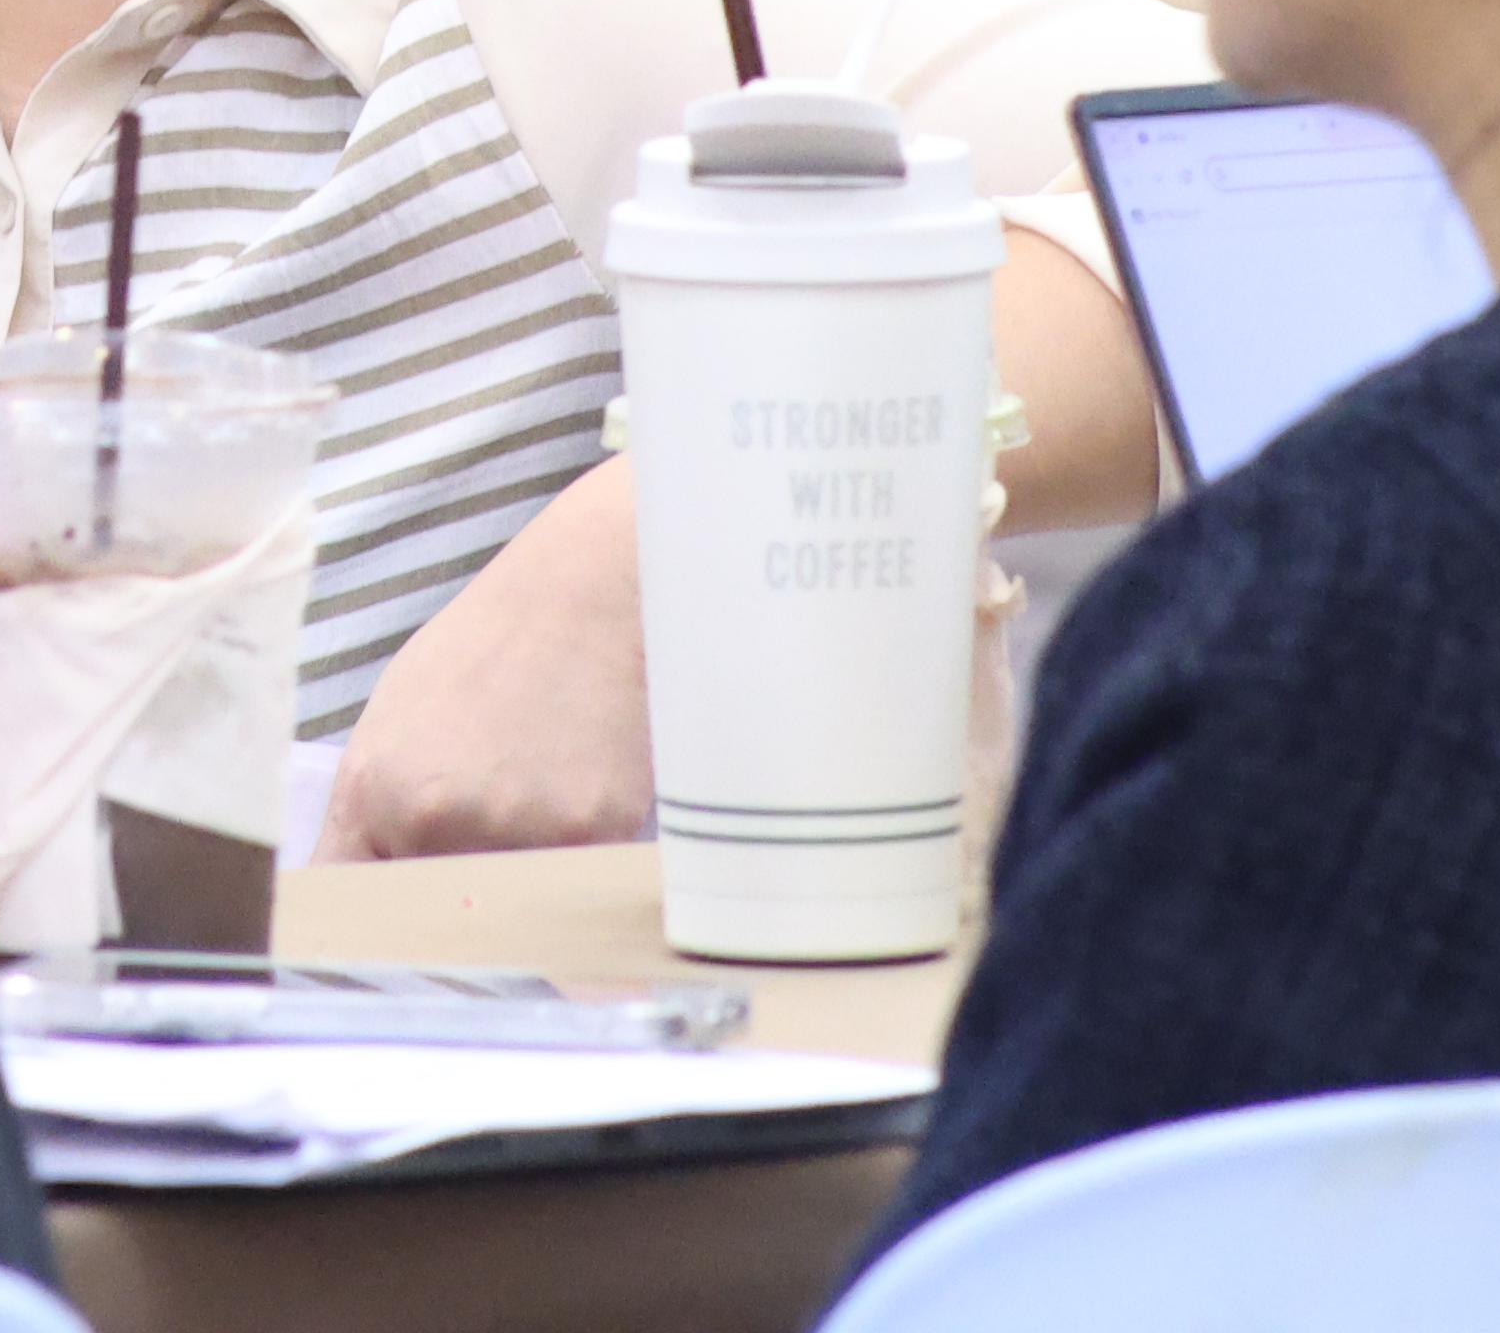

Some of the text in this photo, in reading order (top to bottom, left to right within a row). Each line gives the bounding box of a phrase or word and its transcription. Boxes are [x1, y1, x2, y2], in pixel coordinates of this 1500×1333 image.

[729, 395, 944, 451] STRONGER
[788, 470, 895, 521] WITH
[765, 538, 914, 591] COFFEE
